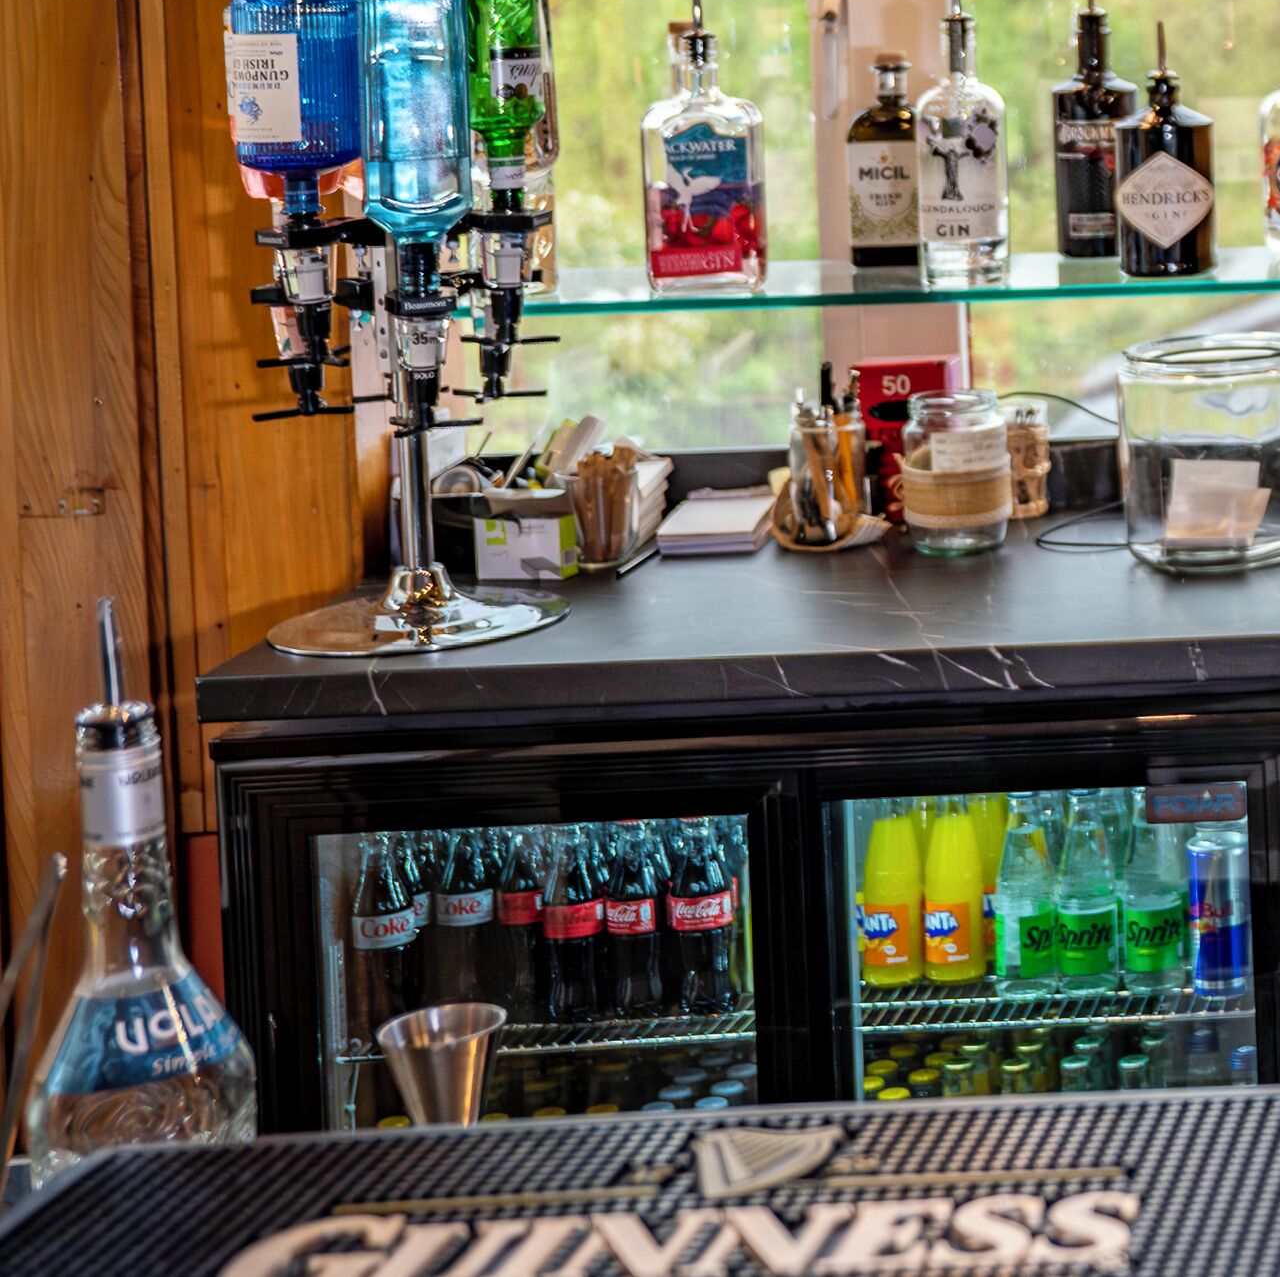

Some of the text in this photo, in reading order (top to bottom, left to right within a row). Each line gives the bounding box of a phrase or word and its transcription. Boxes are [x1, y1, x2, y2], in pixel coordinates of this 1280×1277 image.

[243, 59, 275, 69] IRISH
[666, 139, 737, 154] ACKWATER
[859, 166, 910, 181] MICIL
[1122, 188, 1210, 206] HENDRICK'S
[1151, 210, 1181, 220] GIN
[936, 224, 970, 236] GIN
[404, 299, 447, 311] Beaumont
[413, 372, 436, 380] SOLO
[882, 375, 911, 396] 50
[1153, 793, 1239, 816] POLAR
[675, 897, 722, 919] Coca-Cola
[360, 915, 409, 939] Coke
[218, 1189, 1141, 1277] GUINNESS
